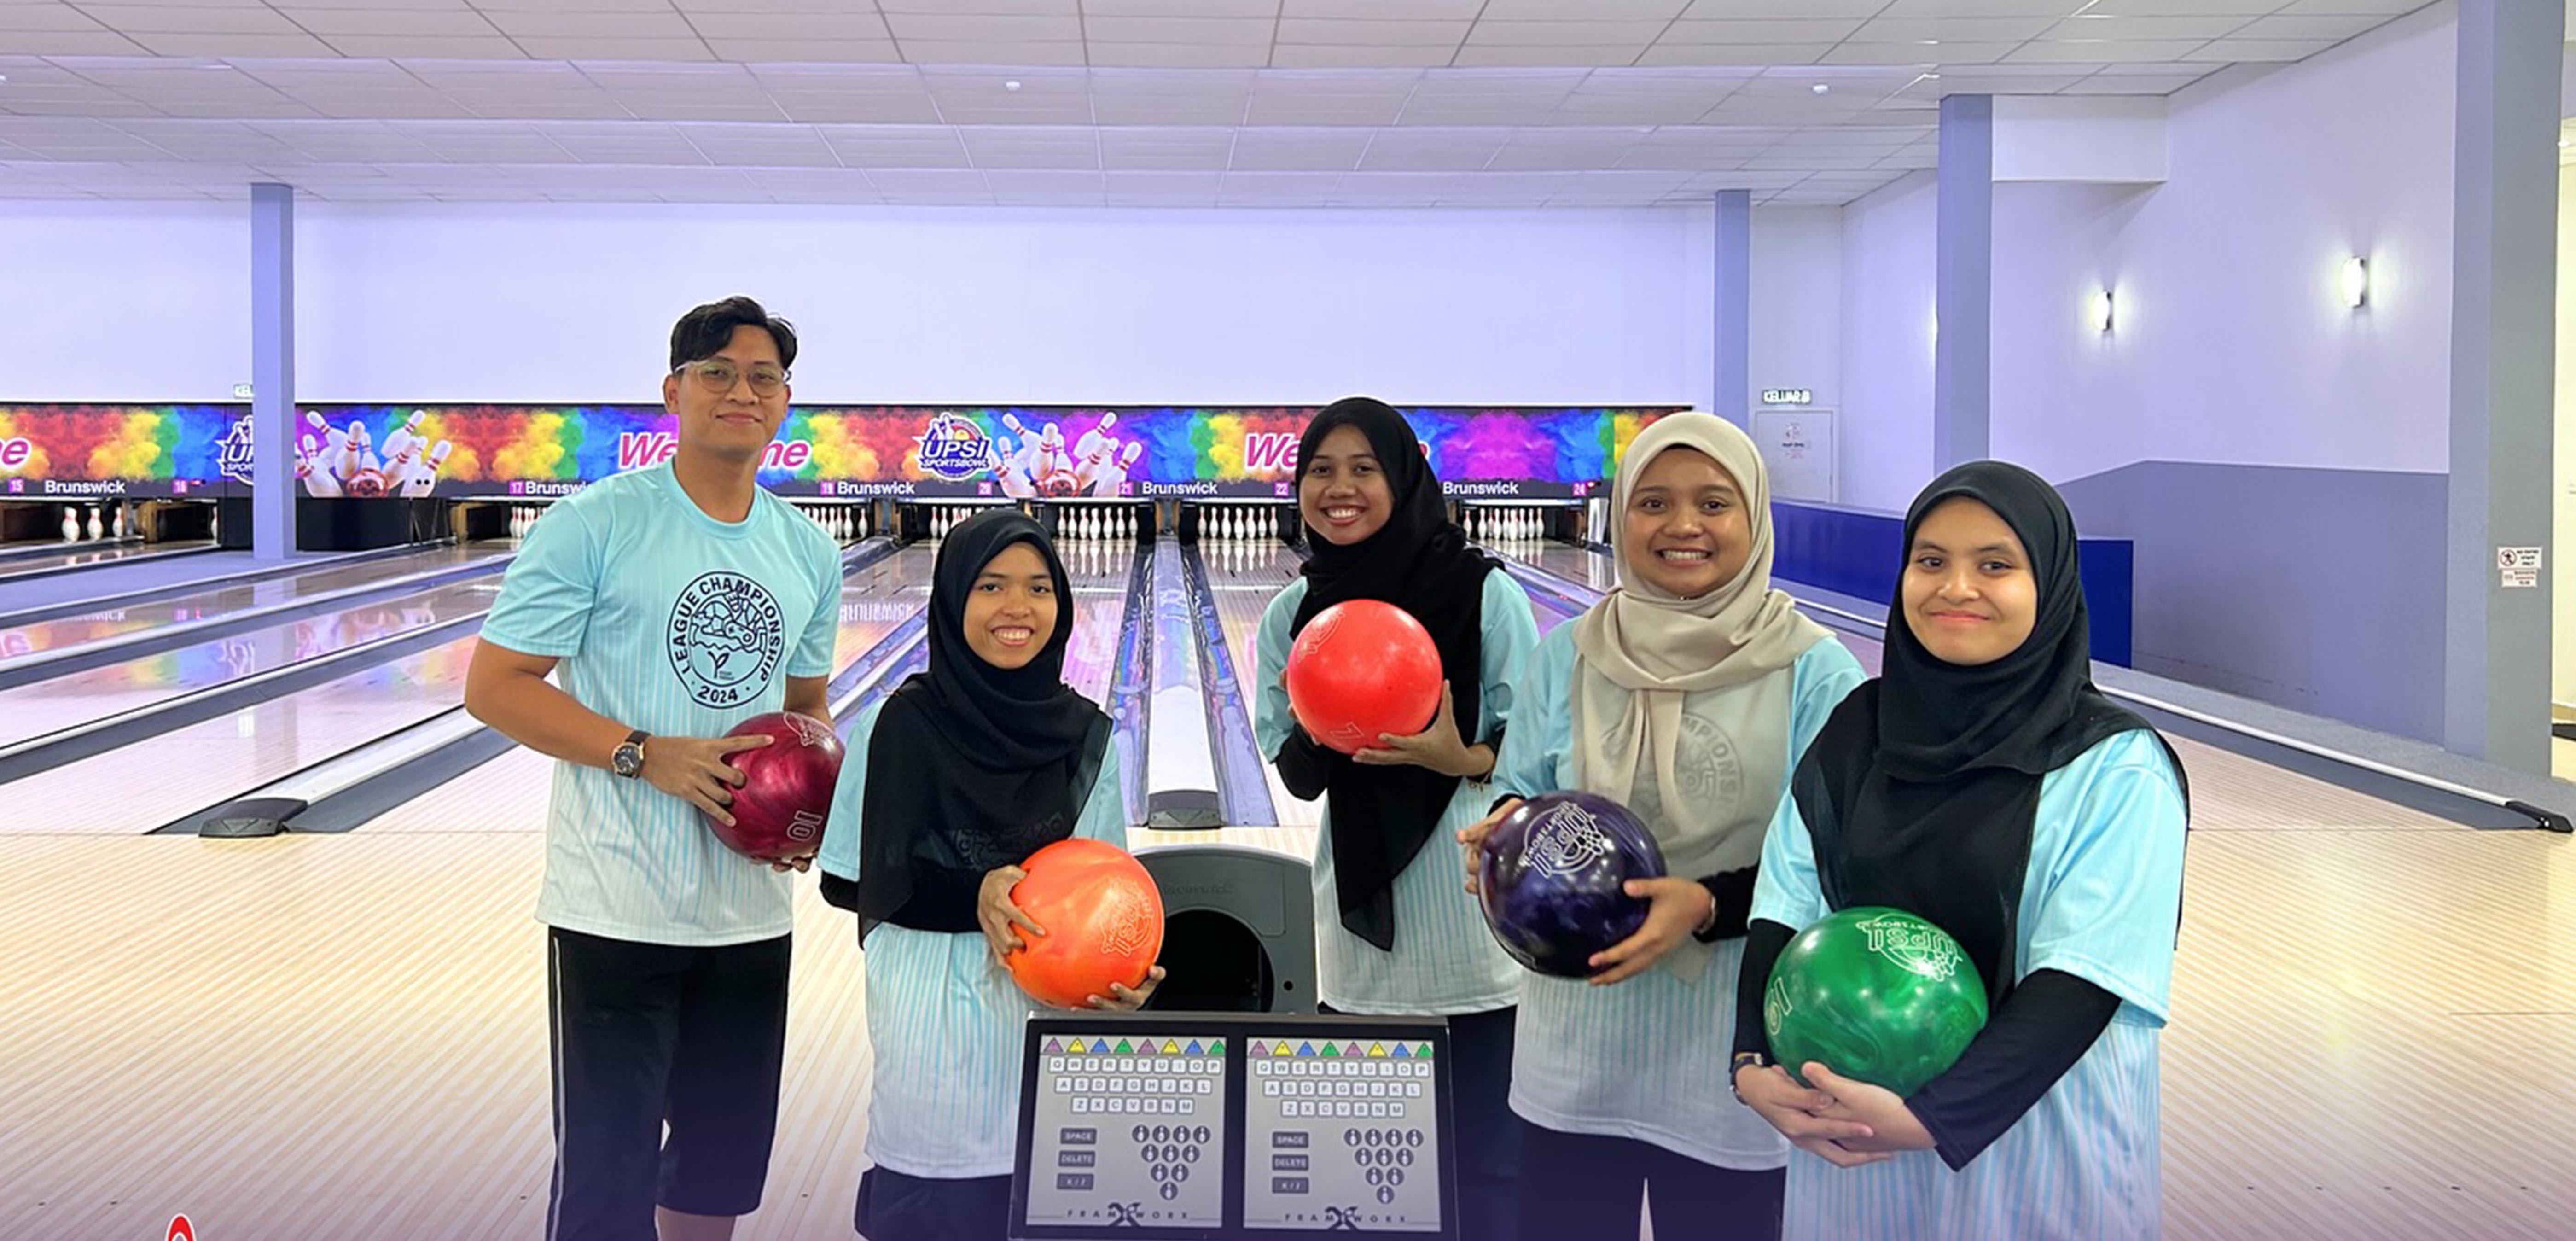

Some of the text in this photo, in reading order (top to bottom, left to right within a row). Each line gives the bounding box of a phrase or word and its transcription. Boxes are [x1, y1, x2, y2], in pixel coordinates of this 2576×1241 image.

[924, 440, 987, 459] UPSI
[45, 480, 126, 493] Brunswick
[512, 482, 523, 494] 17
[837, 482, 915, 495] Brunswick
[1142, 482, 1218, 495] Brunswick
[1275, 483, 1288, 495] 22
[1442, 482, 1519, 495] Brunswick
[1573, 483, 1586, 495] 24
[673, 577, 781, 682] LEAGUE CHAMPIONSHIP
[697, 685, 738, 703] 2024
